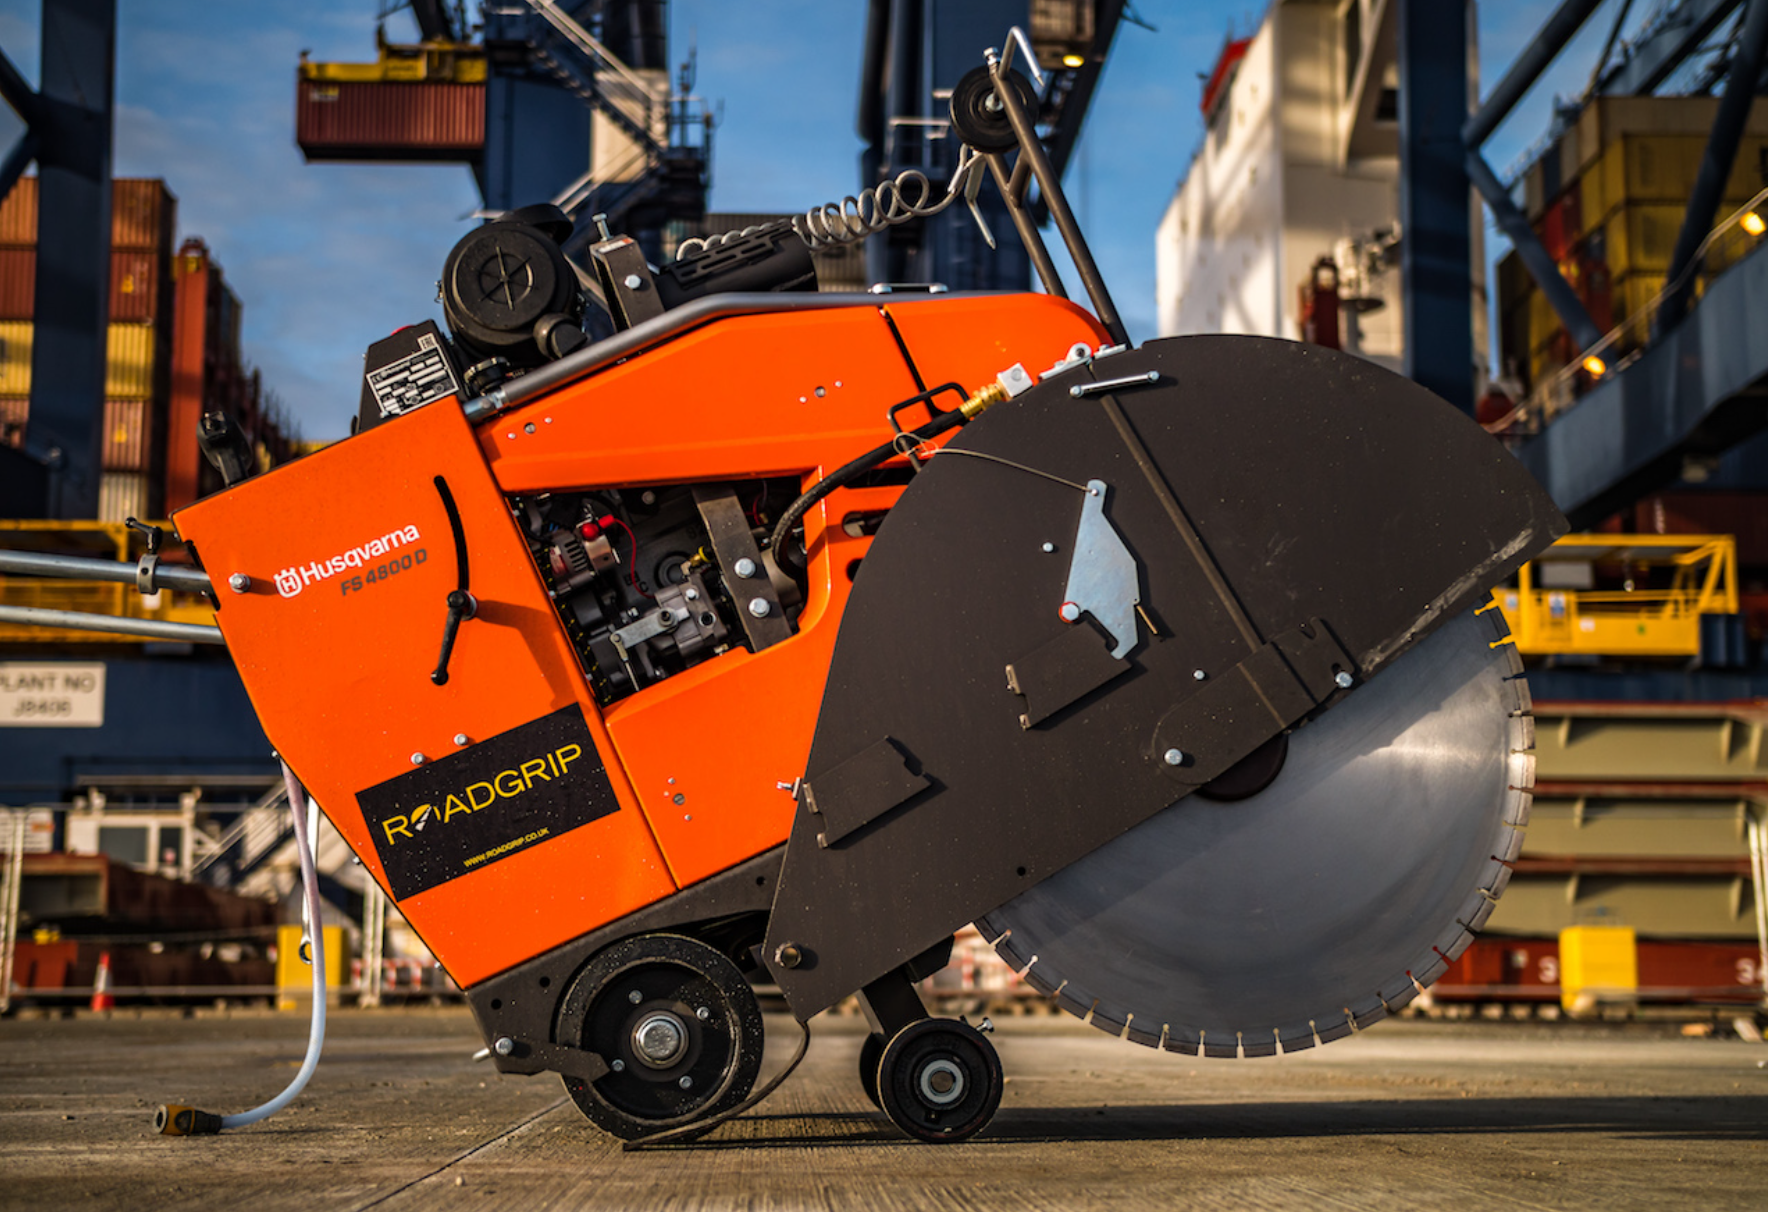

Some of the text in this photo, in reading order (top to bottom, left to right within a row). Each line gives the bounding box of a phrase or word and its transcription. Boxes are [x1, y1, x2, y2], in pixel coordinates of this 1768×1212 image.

[299, 524, 421, 586] Husqvarna
[341, 548, 427, 596] FS 4800 D
[64, 672, 96, 693] NO
[382, 743, 582, 846] ROADGRIP
[463, 827, 550, 868] WWW.ROADGRIP.CO.UK
